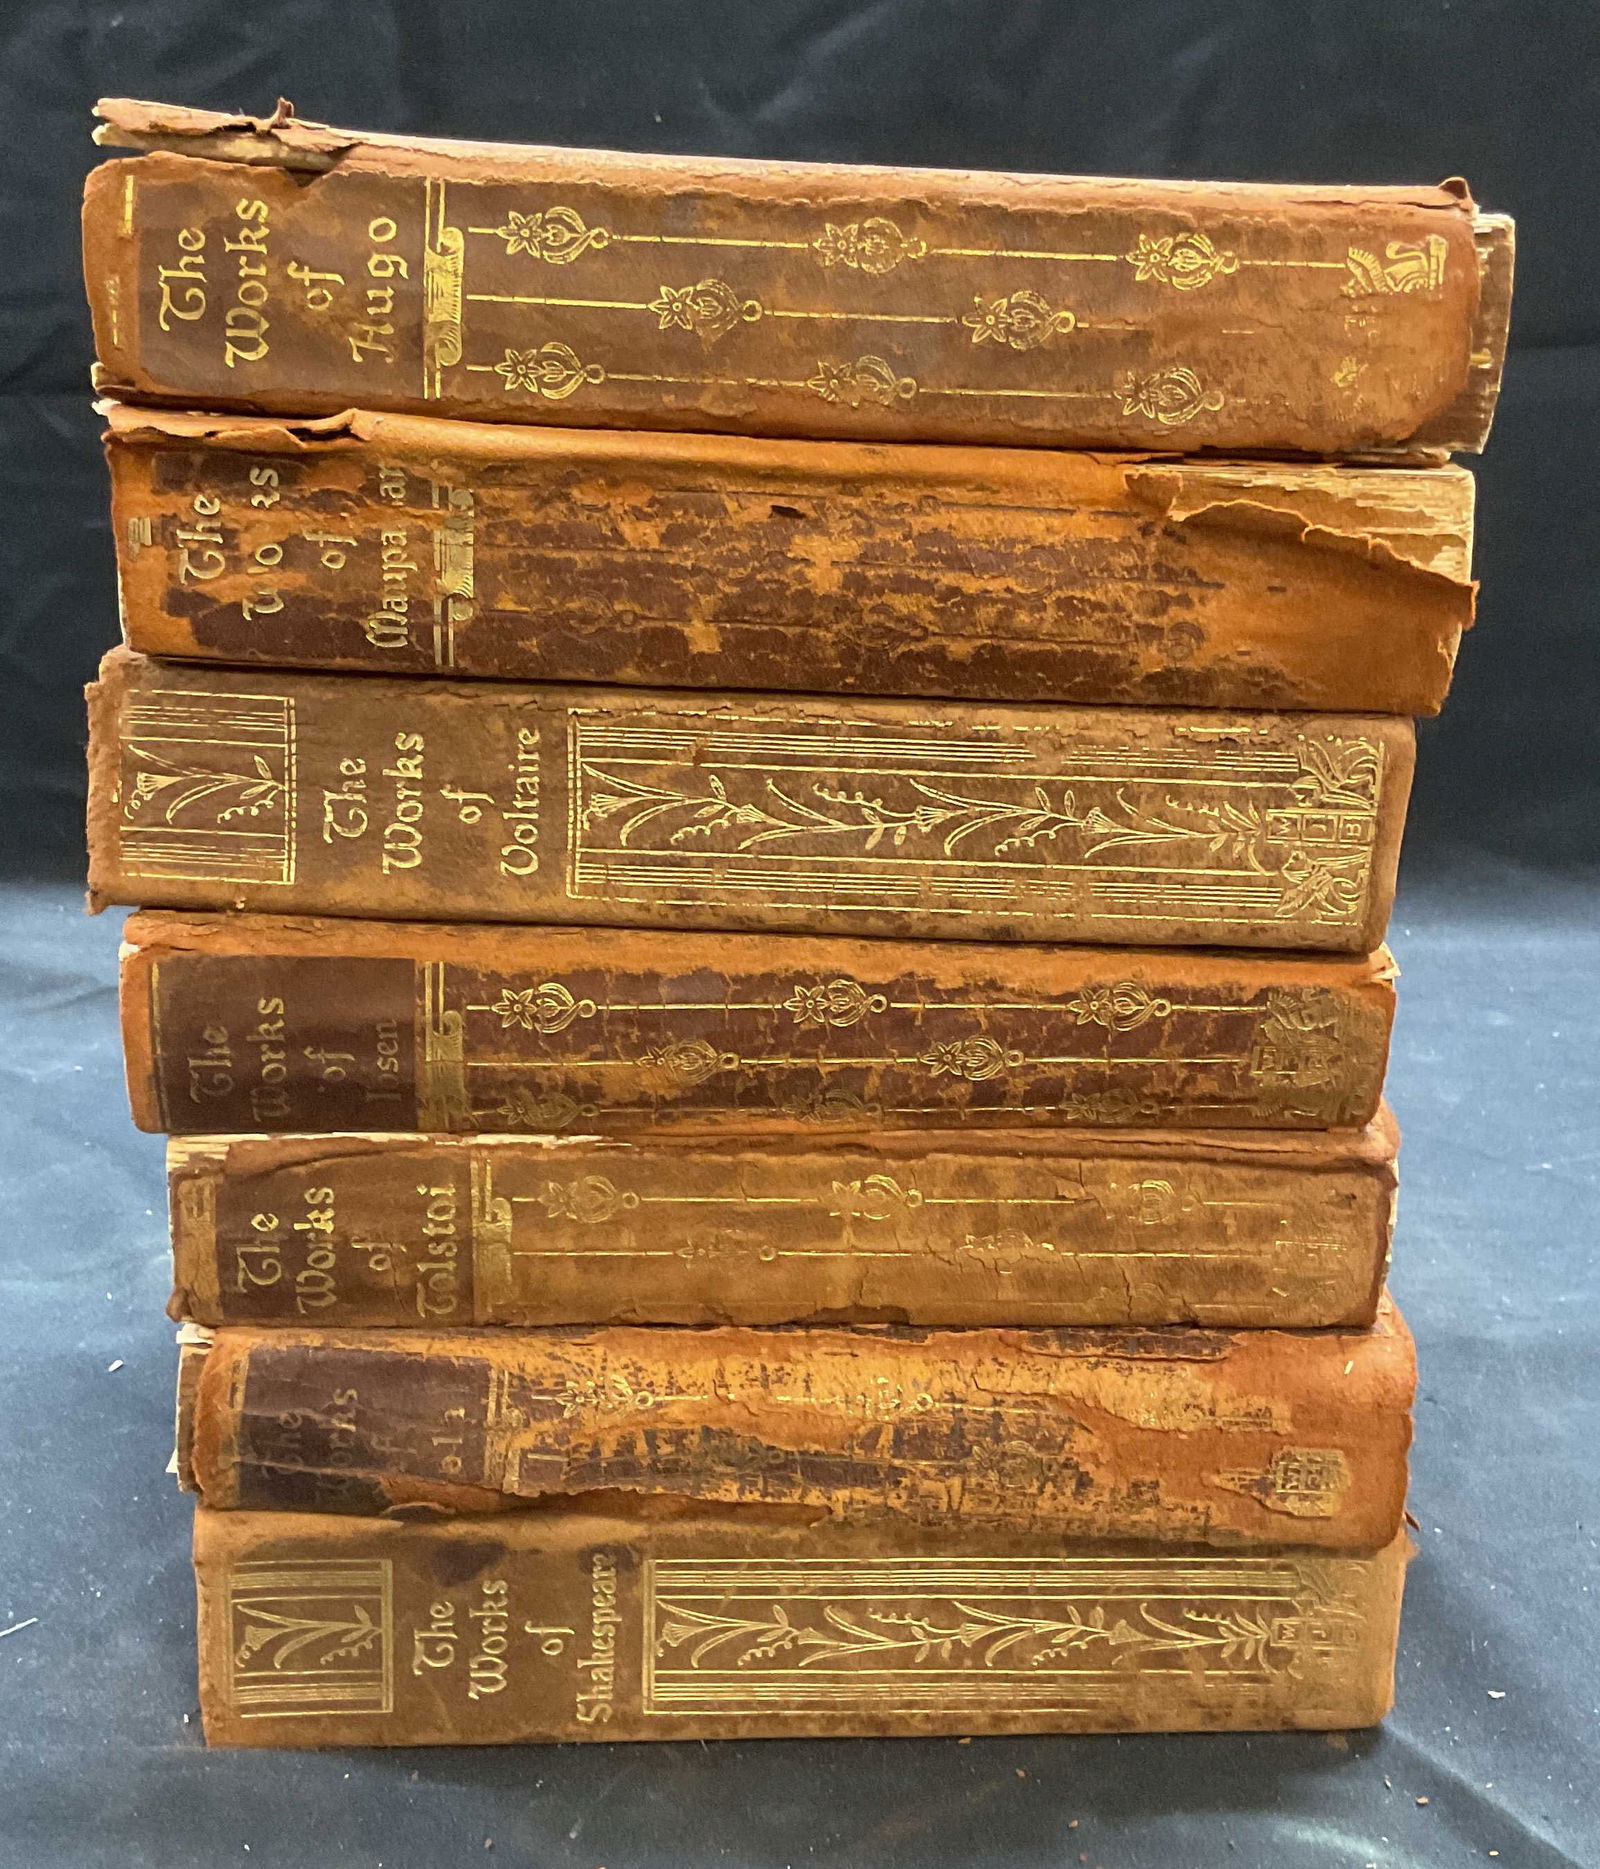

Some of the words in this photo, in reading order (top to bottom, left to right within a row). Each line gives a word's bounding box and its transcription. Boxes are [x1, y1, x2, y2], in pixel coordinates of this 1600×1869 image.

[158, 226, 206, 332] The
[224, 197, 270, 369] Works
[287, 260, 344, 311] of
[352, 215, 409, 363] Hugo
[176, 492, 227, 586] The
[305, 530, 358, 570] of
[322, 756, 369, 845] The
[381, 731, 426, 875] Works
[440, 787, 495, 824] of
[500, 726, 541, 877] Voltaire
[187, 1023, 235, 1104] The
[246, 996, 291, 1122] Works
[303, 1044, 355, 1082] of
[235, 1210, 282, 1293] The
[293, 1186, 337, 1315] Works
[351, 1240, 407, 1272] of
[416, 1183, 459, 1319] Tolstoi
[413, 1601, 459, 1677] The
[468, 1579, 509, 1700] Works
[524, 1620, 576, 1656] of
